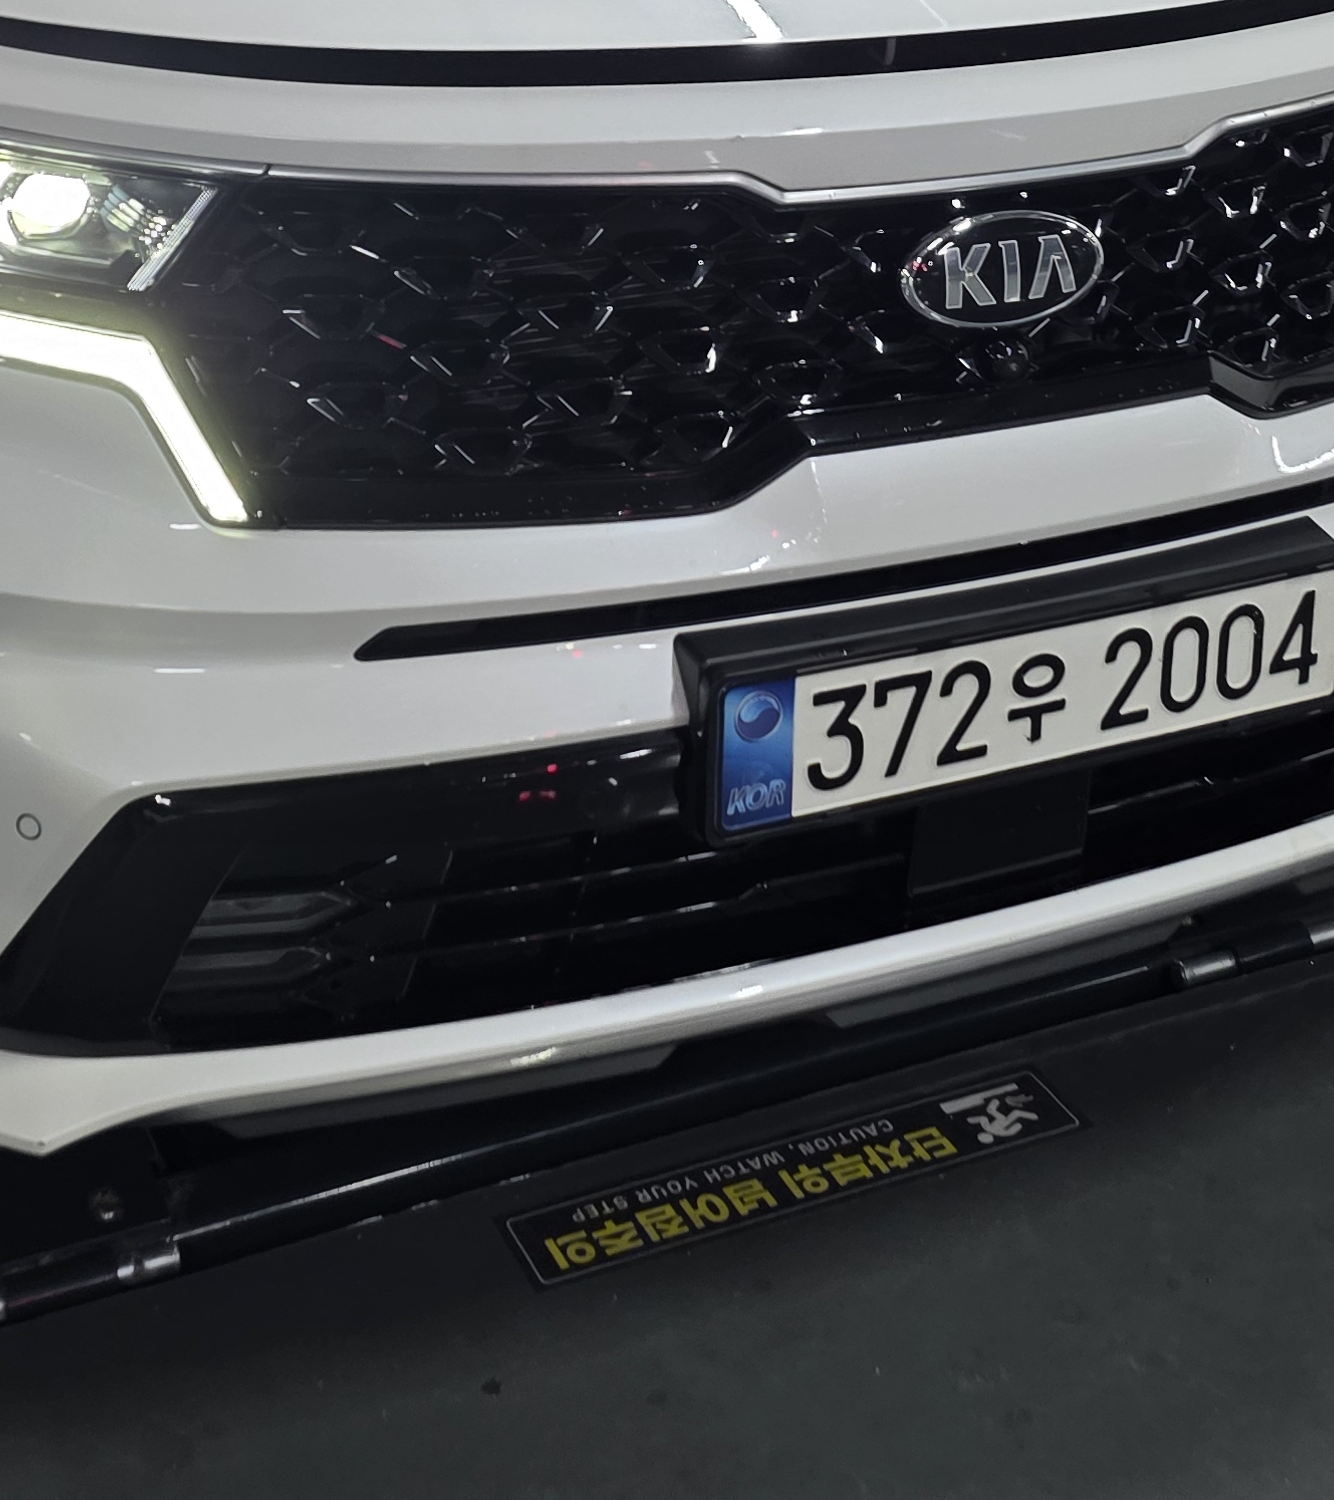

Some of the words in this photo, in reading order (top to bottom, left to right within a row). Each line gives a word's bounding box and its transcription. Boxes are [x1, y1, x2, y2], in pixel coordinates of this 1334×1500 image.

[943, 234, 1077, 310] KIA
[805, 653, 1068, 792] 372우
[1099, 589, 1319, 731] 2004
[727, 778, 788, 816] KOR
[634, 1175, 698, 1205] YOUR
[703, 1150, 786, 1184] WATCH
[777, 1126, 959, 1200] 단차부위
[544, 1177, 779, 1272] 넘어짐주의
[571, 1195, 629, 1223] STEP
